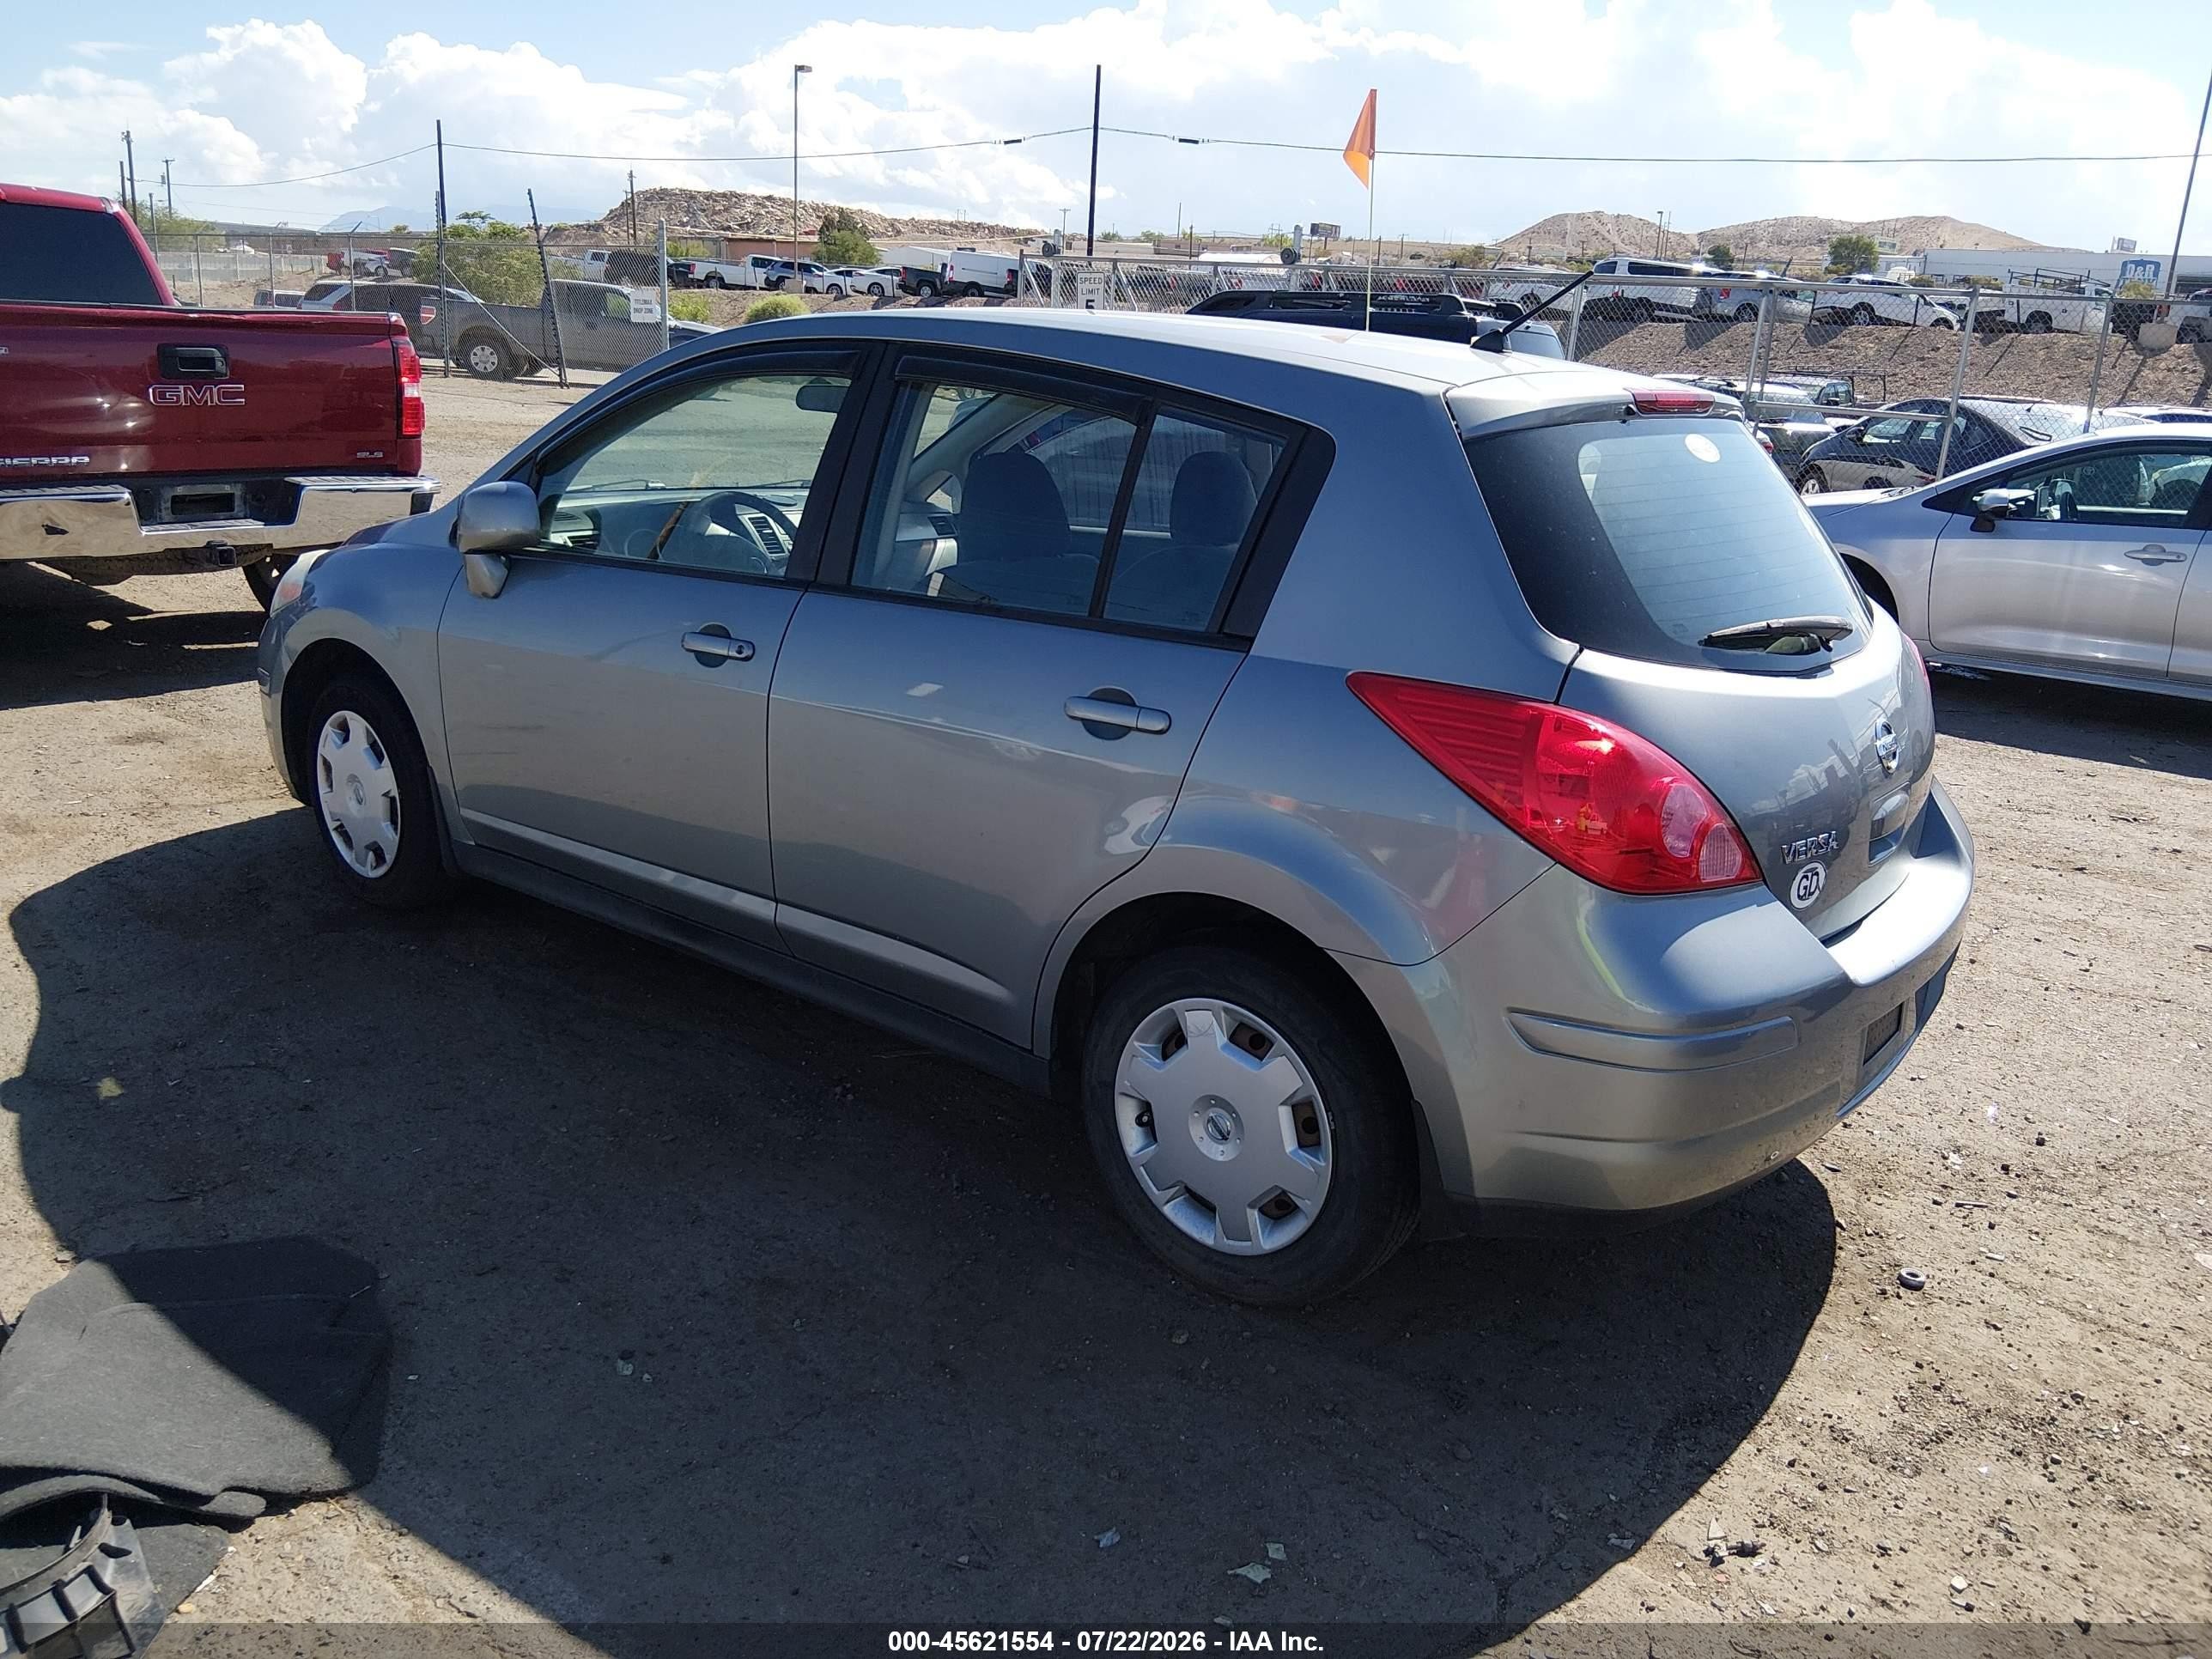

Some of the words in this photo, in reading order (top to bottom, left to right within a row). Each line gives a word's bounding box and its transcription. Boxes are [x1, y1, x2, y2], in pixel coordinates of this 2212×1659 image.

[2126, 263, 2155, 279] D&R
[1079, 276, 1103, 285] SPEED
[1081, 288, 1100, 296] LIMIT
[1085, 299, 1096, 309] 5
[149, 384, 246, 406] GMC
[0, 455, 90, 467] IERRA
[1780, 830, 1840, 865] VERSA
